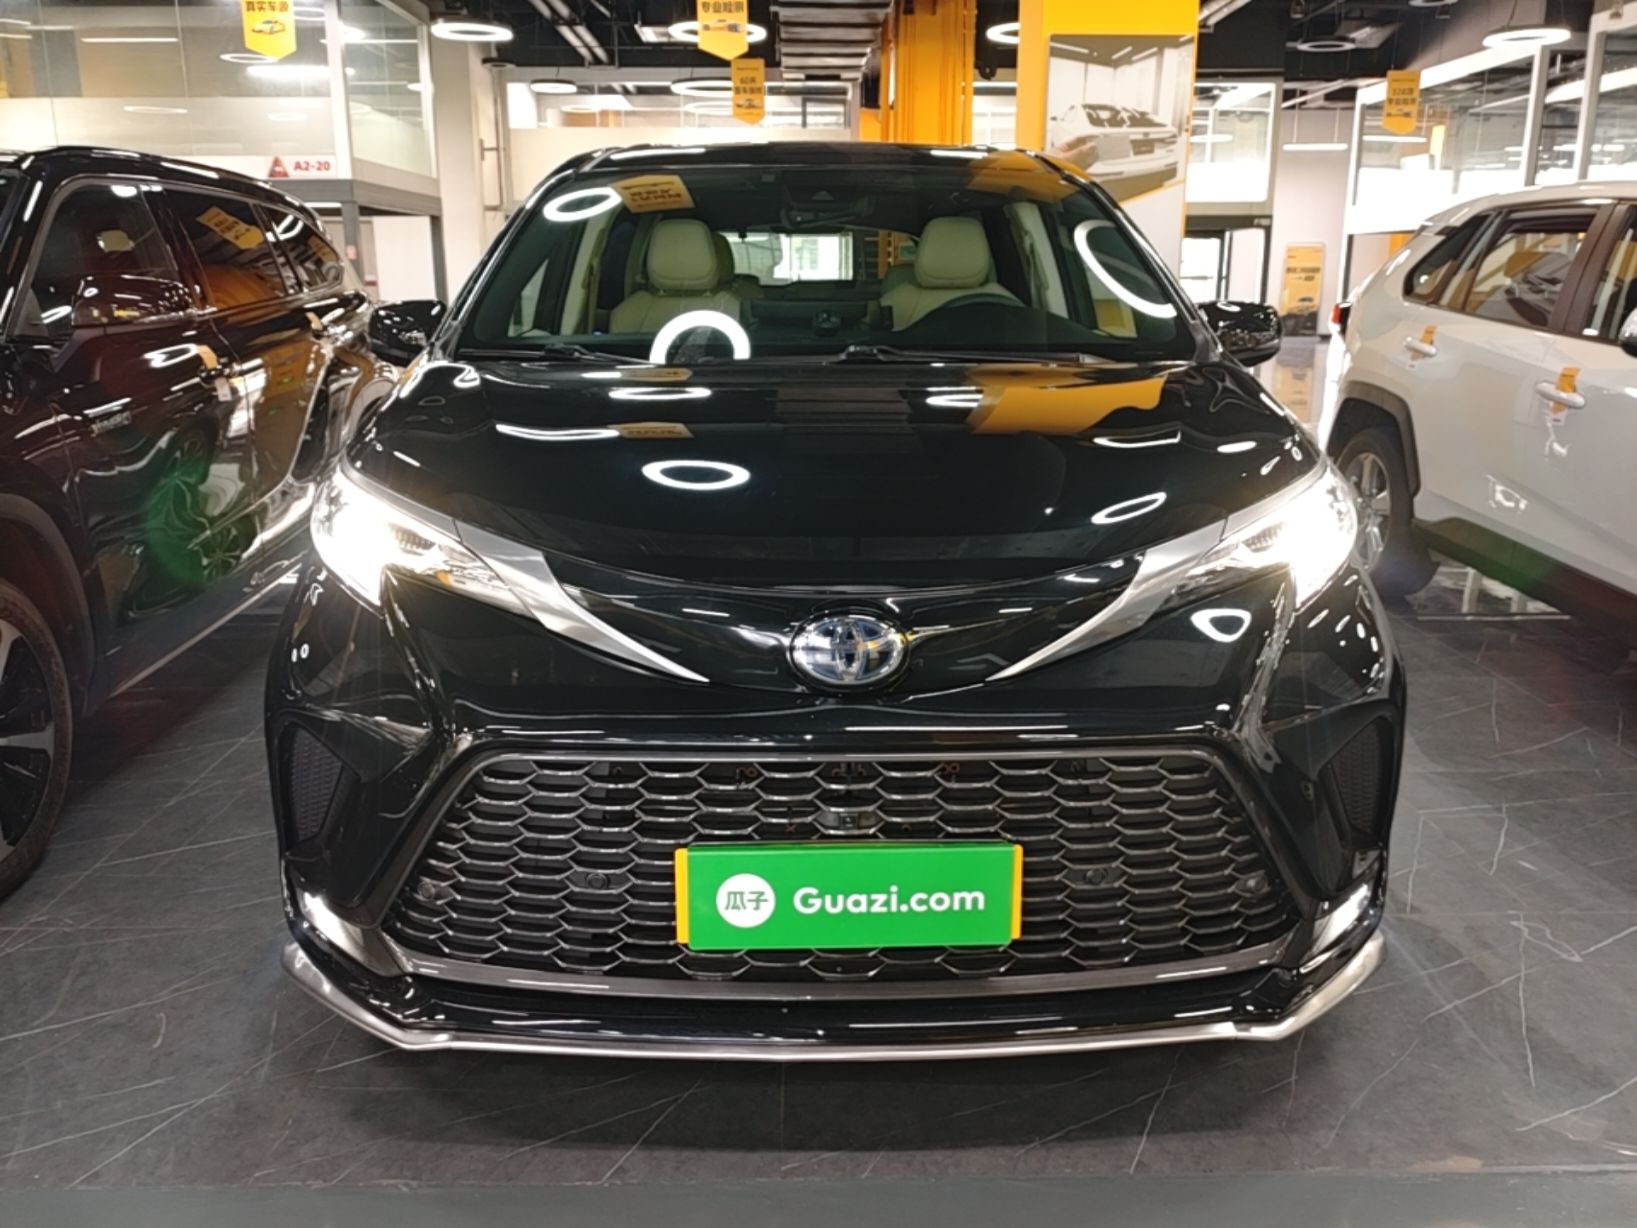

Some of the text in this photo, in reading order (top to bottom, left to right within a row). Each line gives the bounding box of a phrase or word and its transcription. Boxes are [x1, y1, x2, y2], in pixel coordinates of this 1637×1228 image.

[293, 161, 331, 172] A2-20
[724, 890, 769, 912] 瓜子
[793, 885, 986, 915] Guazi.com
